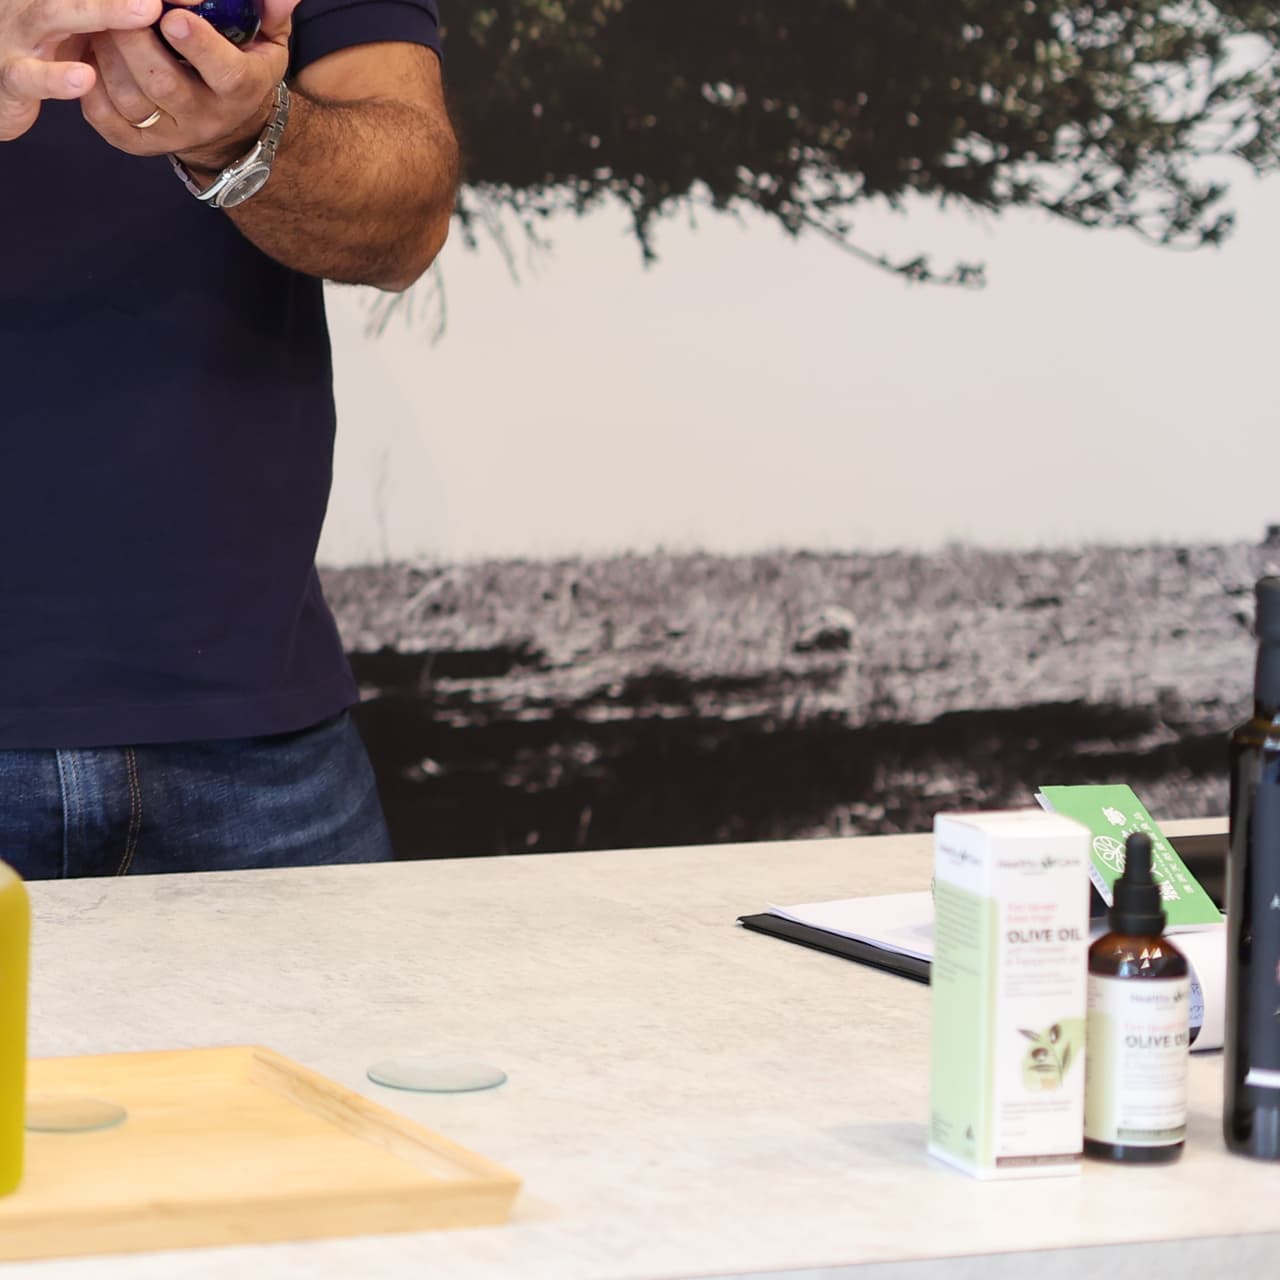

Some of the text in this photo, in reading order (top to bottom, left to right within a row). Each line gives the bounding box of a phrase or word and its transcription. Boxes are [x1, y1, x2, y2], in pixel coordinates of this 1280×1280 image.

[1008, 927, 1083, 944] OLIVE OIL
[1125, 1033, 1172, 1049] OLIVE
